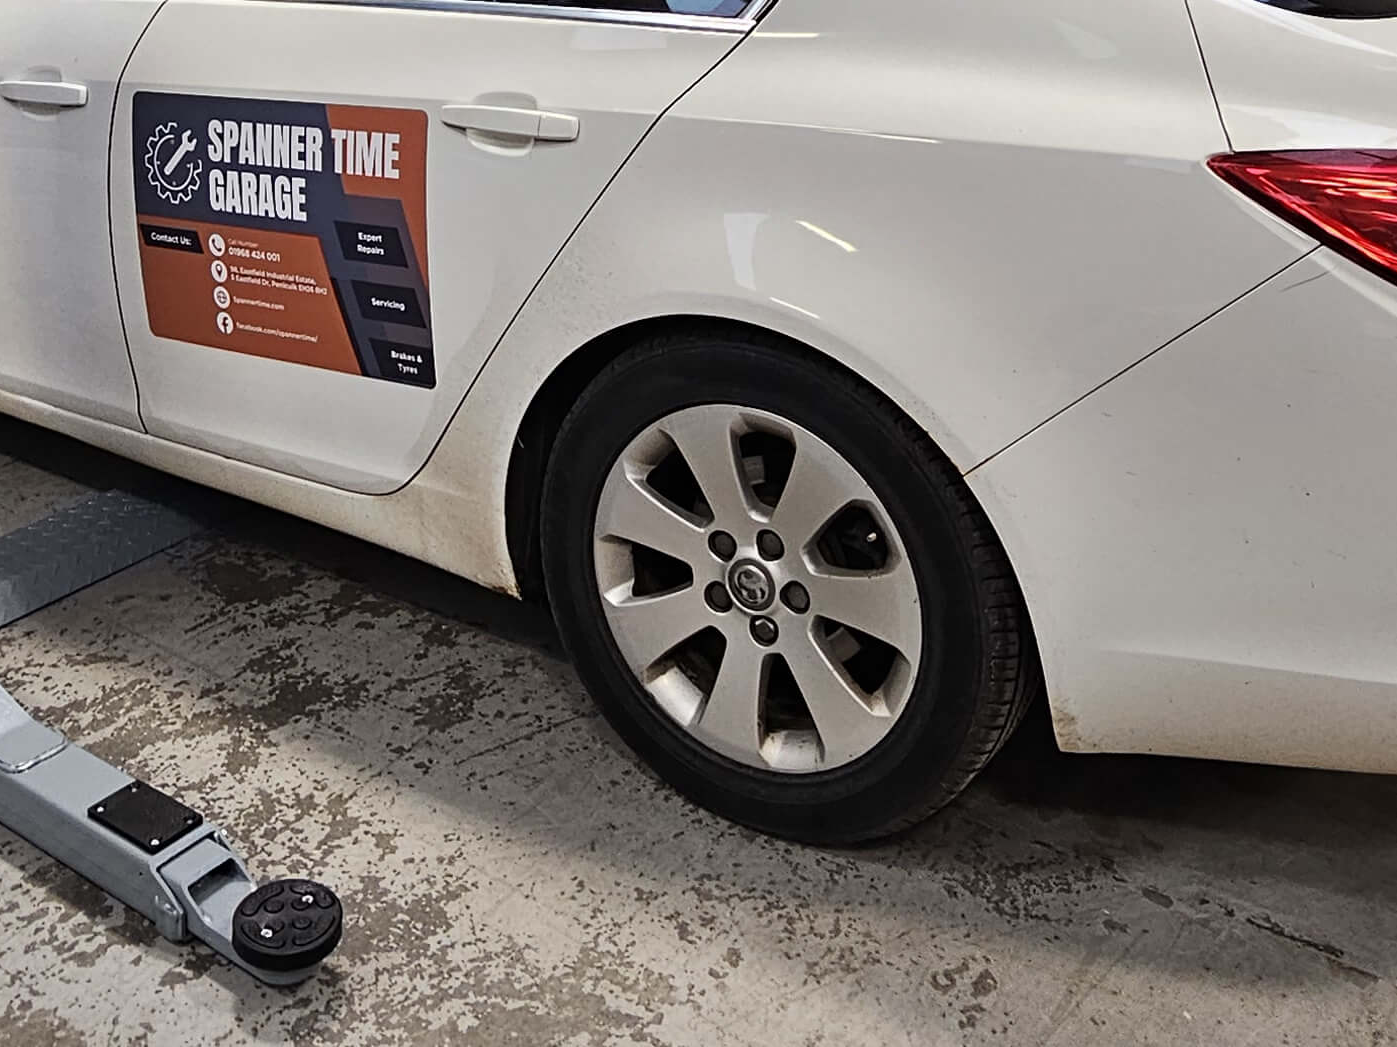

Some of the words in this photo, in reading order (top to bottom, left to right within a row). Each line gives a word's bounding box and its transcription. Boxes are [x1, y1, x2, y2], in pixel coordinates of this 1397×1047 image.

[207, 119, 323, 172] SPANNER
[331, 128, 400, 180] TIME
[209, 169, 307, 222] GARAGE
[150, 232, 179, 244] Contact
[180, 236, 192, 245] Us:
[358, 232, 382, 242] Expert
[357, 244, 384, 255] Repairs
[266, 252, 281, 263] 001
[371, 297, 405, 312] Servicing
[390, 350, 416, 363] Brakes
[416, 354, 423, 363] &
[397, 362, 418, 375] Tyres
